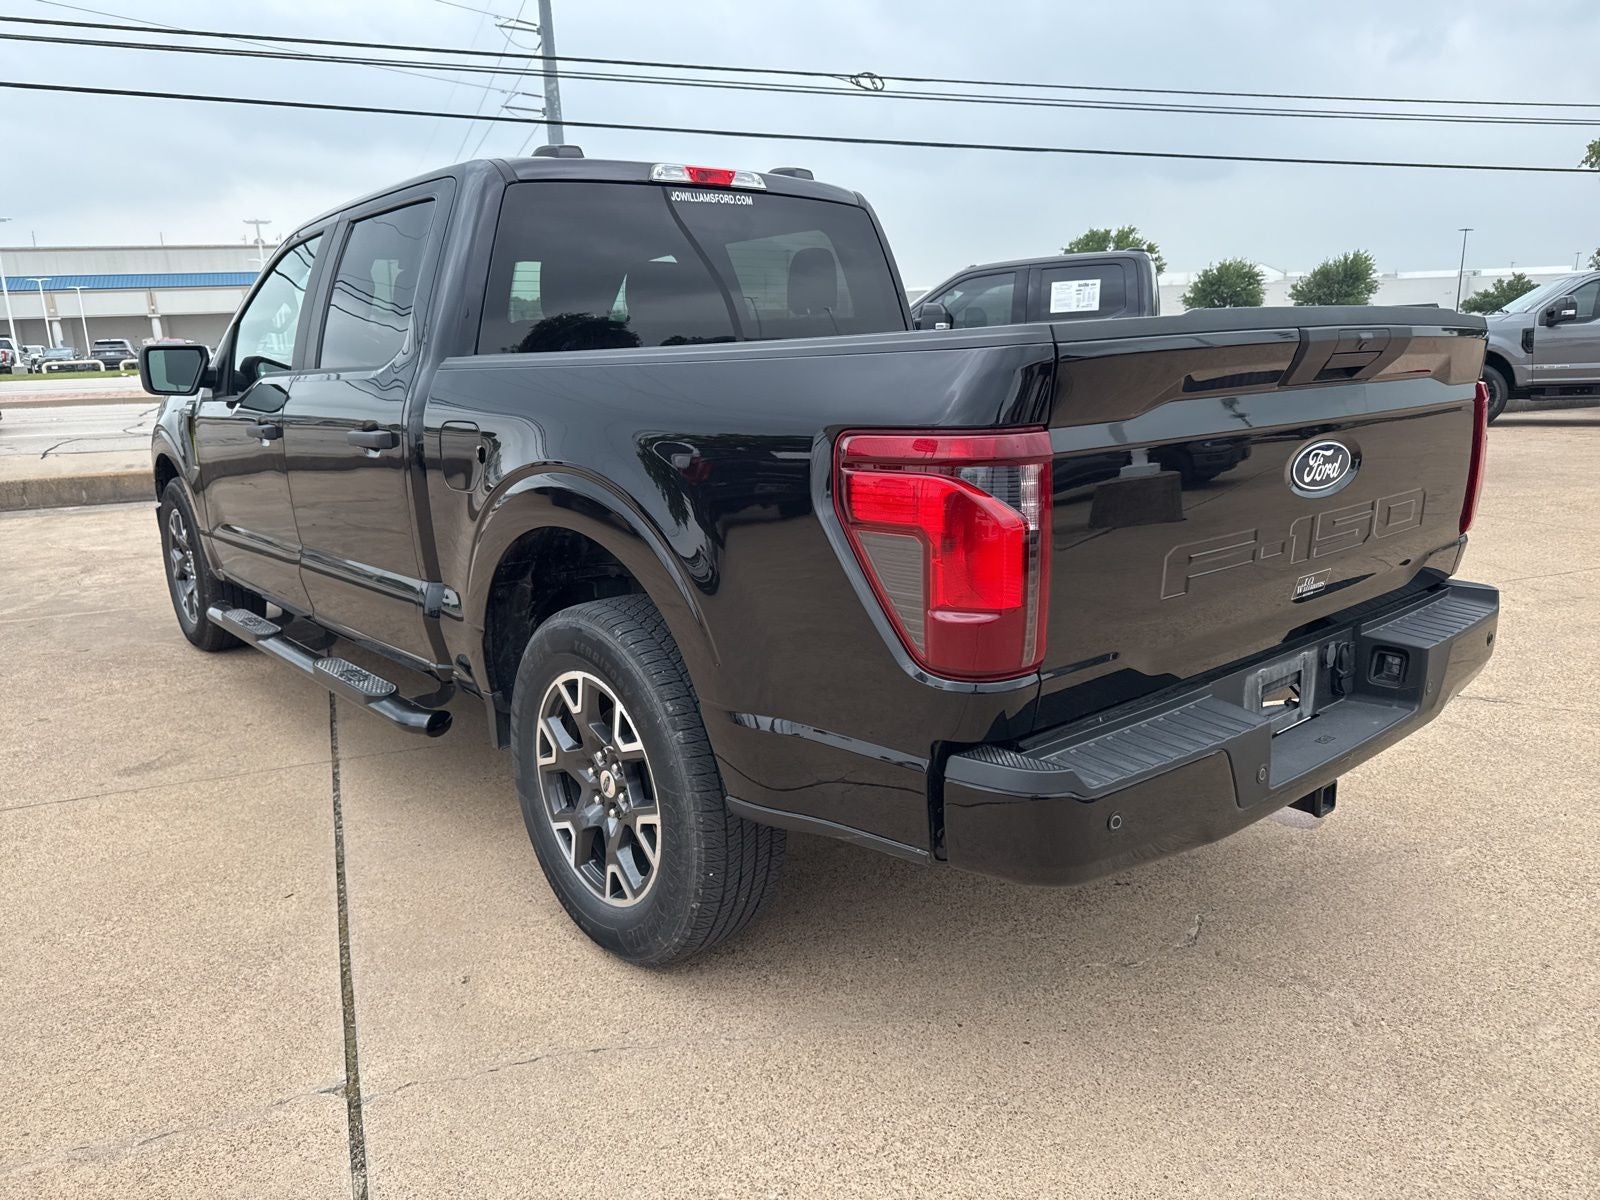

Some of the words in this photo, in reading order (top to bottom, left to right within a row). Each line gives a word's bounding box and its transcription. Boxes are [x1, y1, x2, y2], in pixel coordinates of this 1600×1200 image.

[671, 191, 753, 205] JOWILLIAMSFORD.COM
[1303, 449, 1342, 483] Ford
[1160, 487, 1425, 599] F-150
